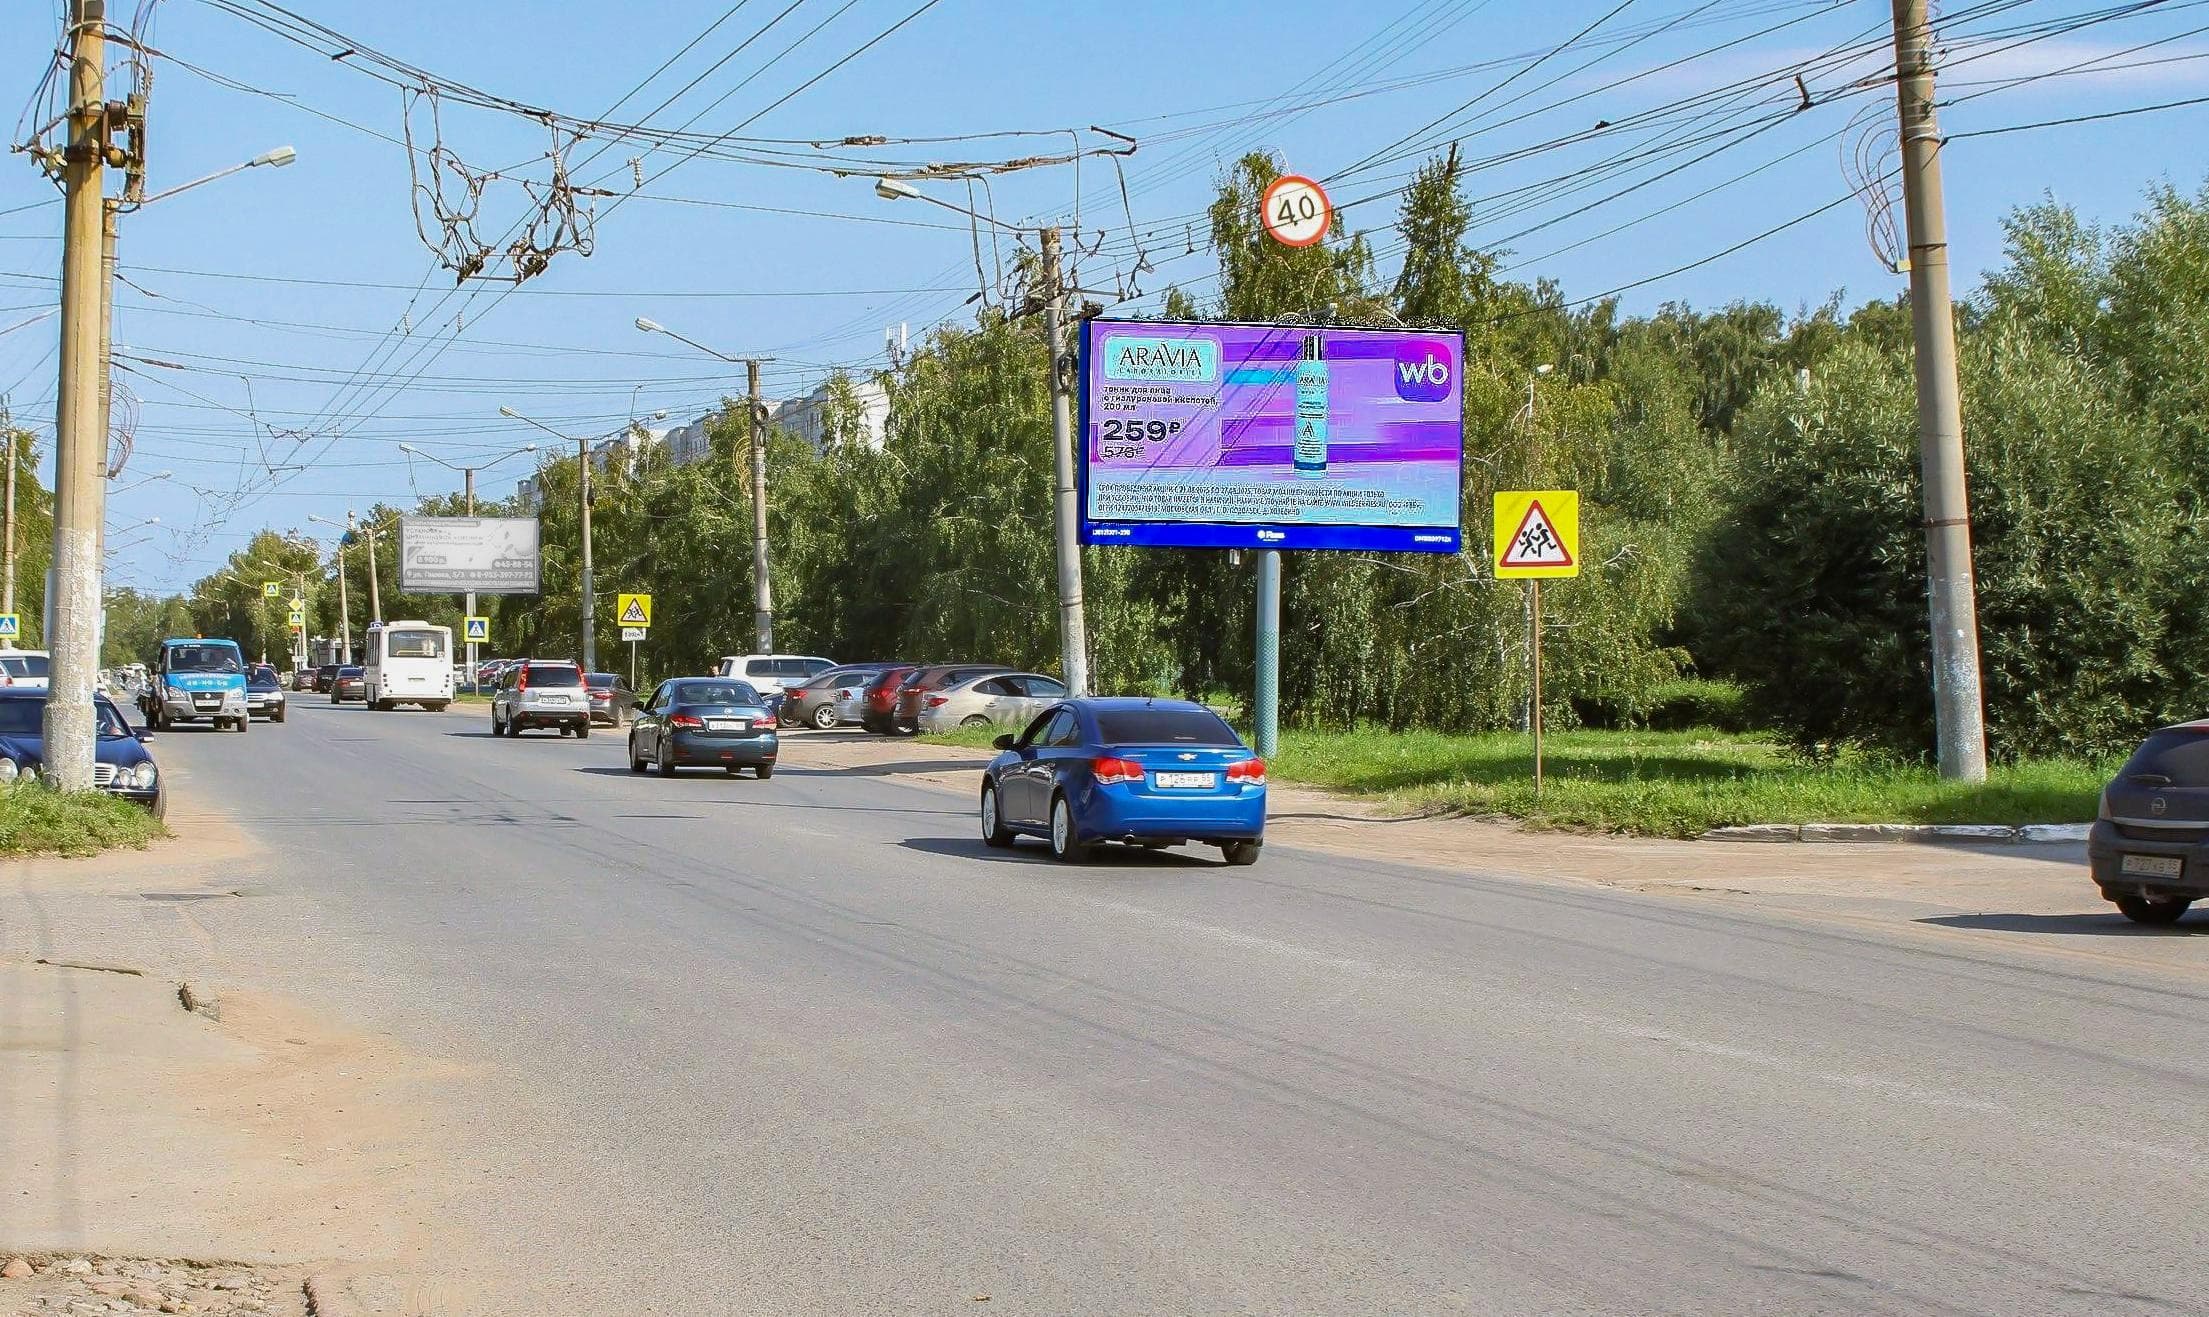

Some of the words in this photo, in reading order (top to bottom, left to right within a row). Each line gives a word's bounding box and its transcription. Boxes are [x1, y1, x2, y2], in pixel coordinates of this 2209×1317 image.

[1278, 195, 1315, 222] 40
[1119, 343, 1202, 367] ARAVIA
[1399, 354, 1449, 385] wb
